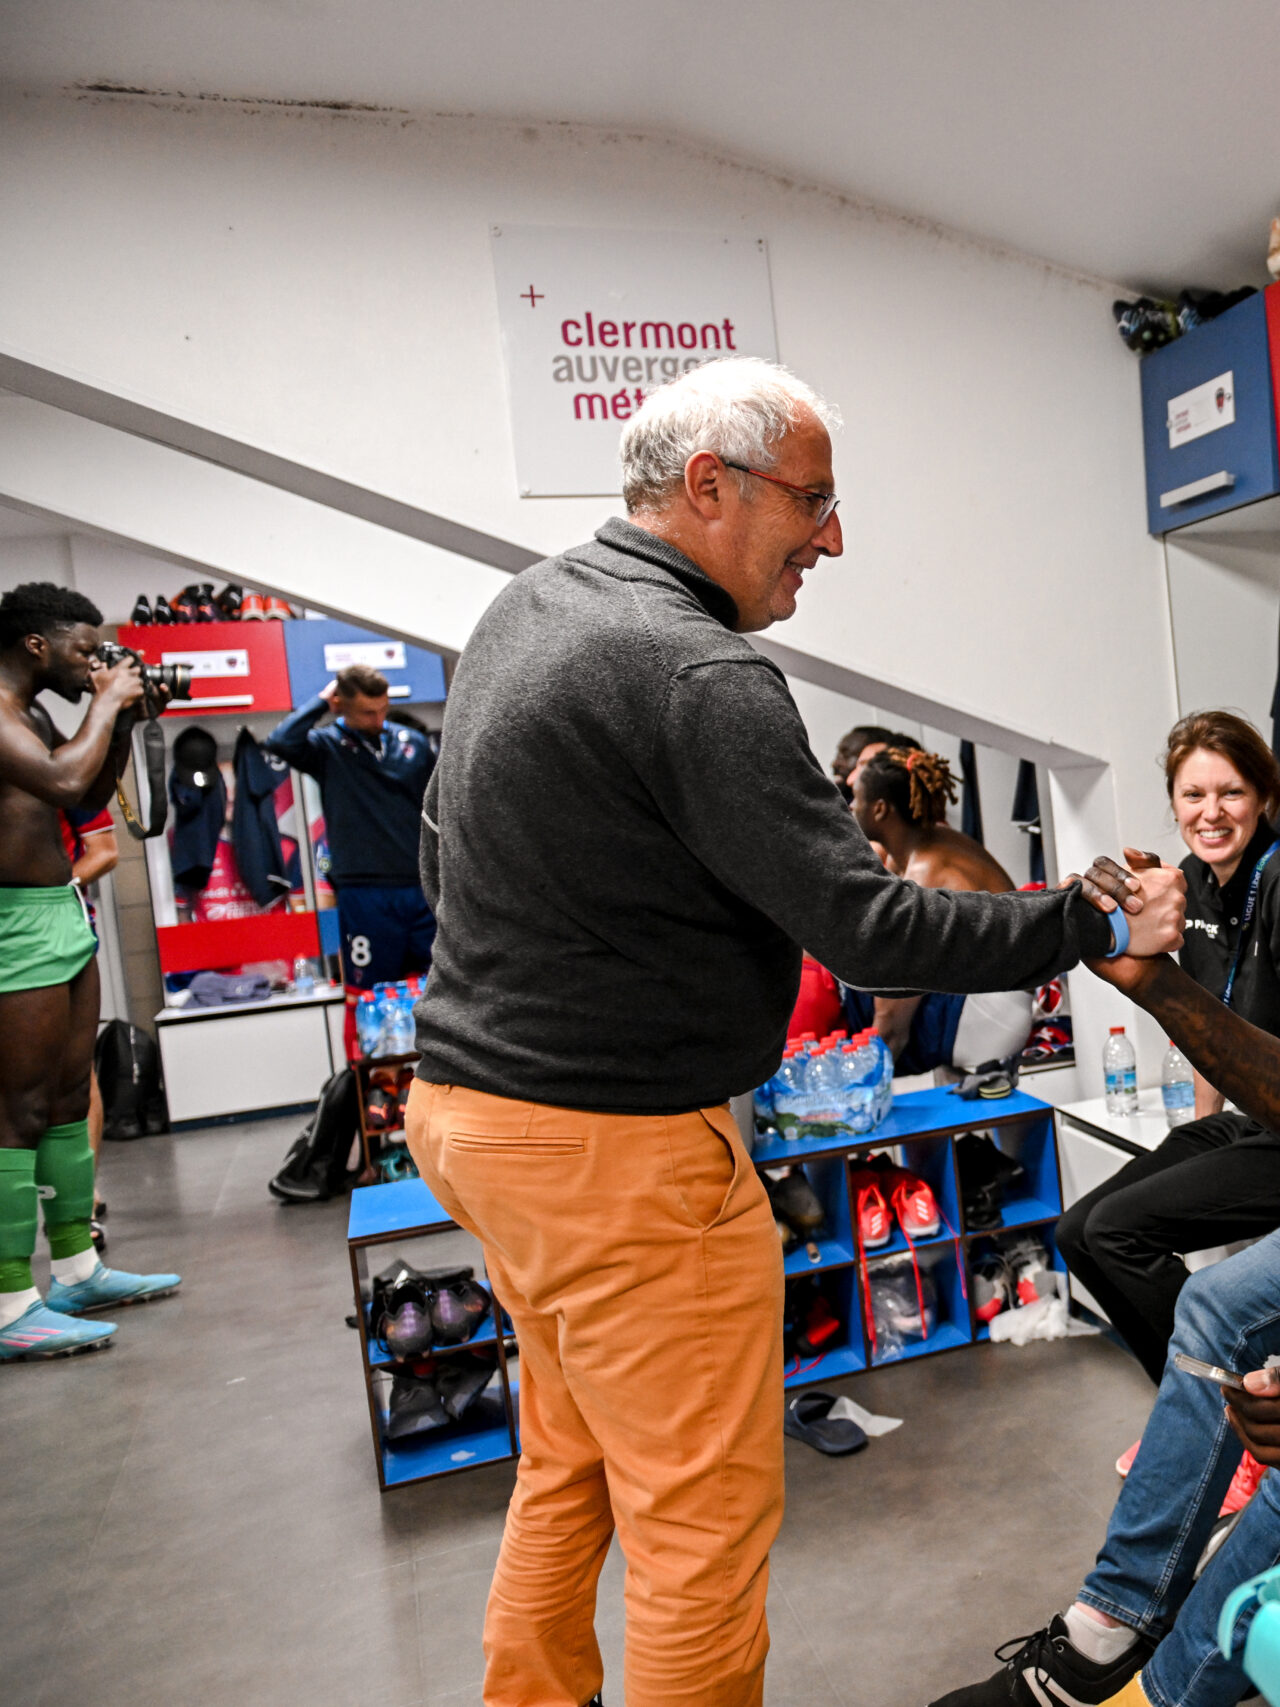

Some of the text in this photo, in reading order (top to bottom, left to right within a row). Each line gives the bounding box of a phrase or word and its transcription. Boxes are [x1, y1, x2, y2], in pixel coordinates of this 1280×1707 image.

[561, 312, 736, 350] clermont
[552, 353, 722, 384] auverg
[350, 935, 372, 967] 8
